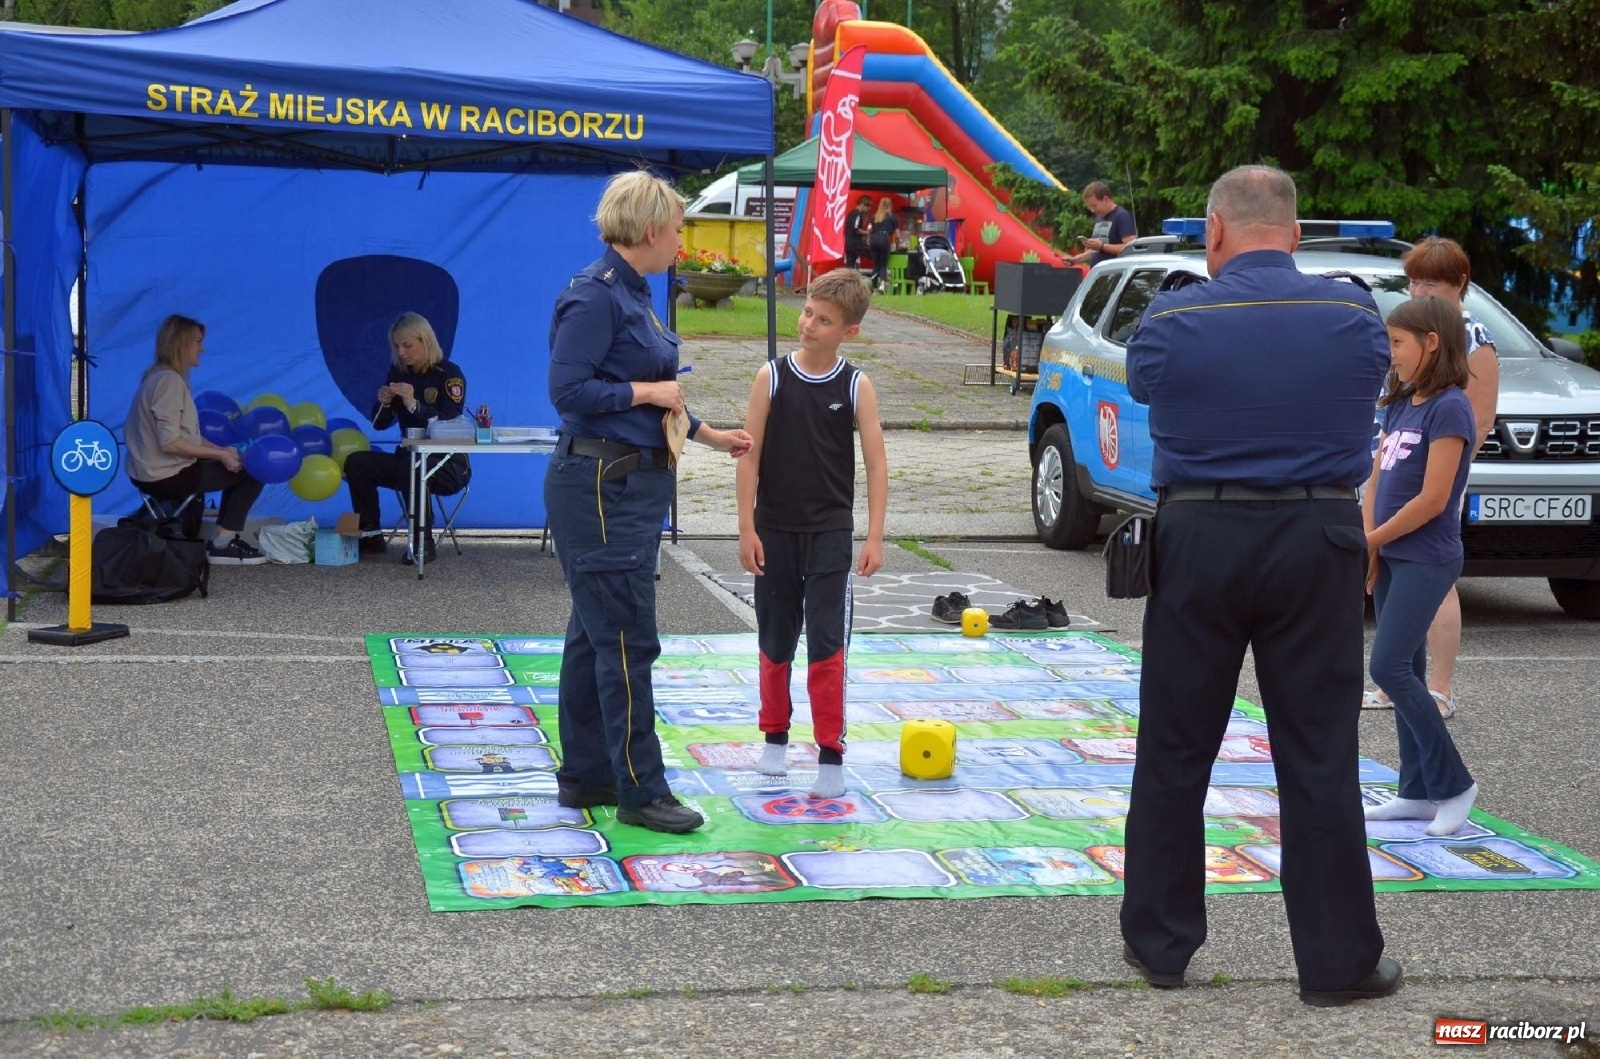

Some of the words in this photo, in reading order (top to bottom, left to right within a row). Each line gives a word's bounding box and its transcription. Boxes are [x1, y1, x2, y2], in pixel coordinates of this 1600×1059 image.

[147, 83, 259, 117] STRAŻ
[269, 92, 412, 127] MIEJSKA
[420, 102, 451, 130] W
[460, 105, 644, 140] RACIBORZU
[1484, 497, 1525, 518] SRC
[1533, 497, 1587, 518] CF60
